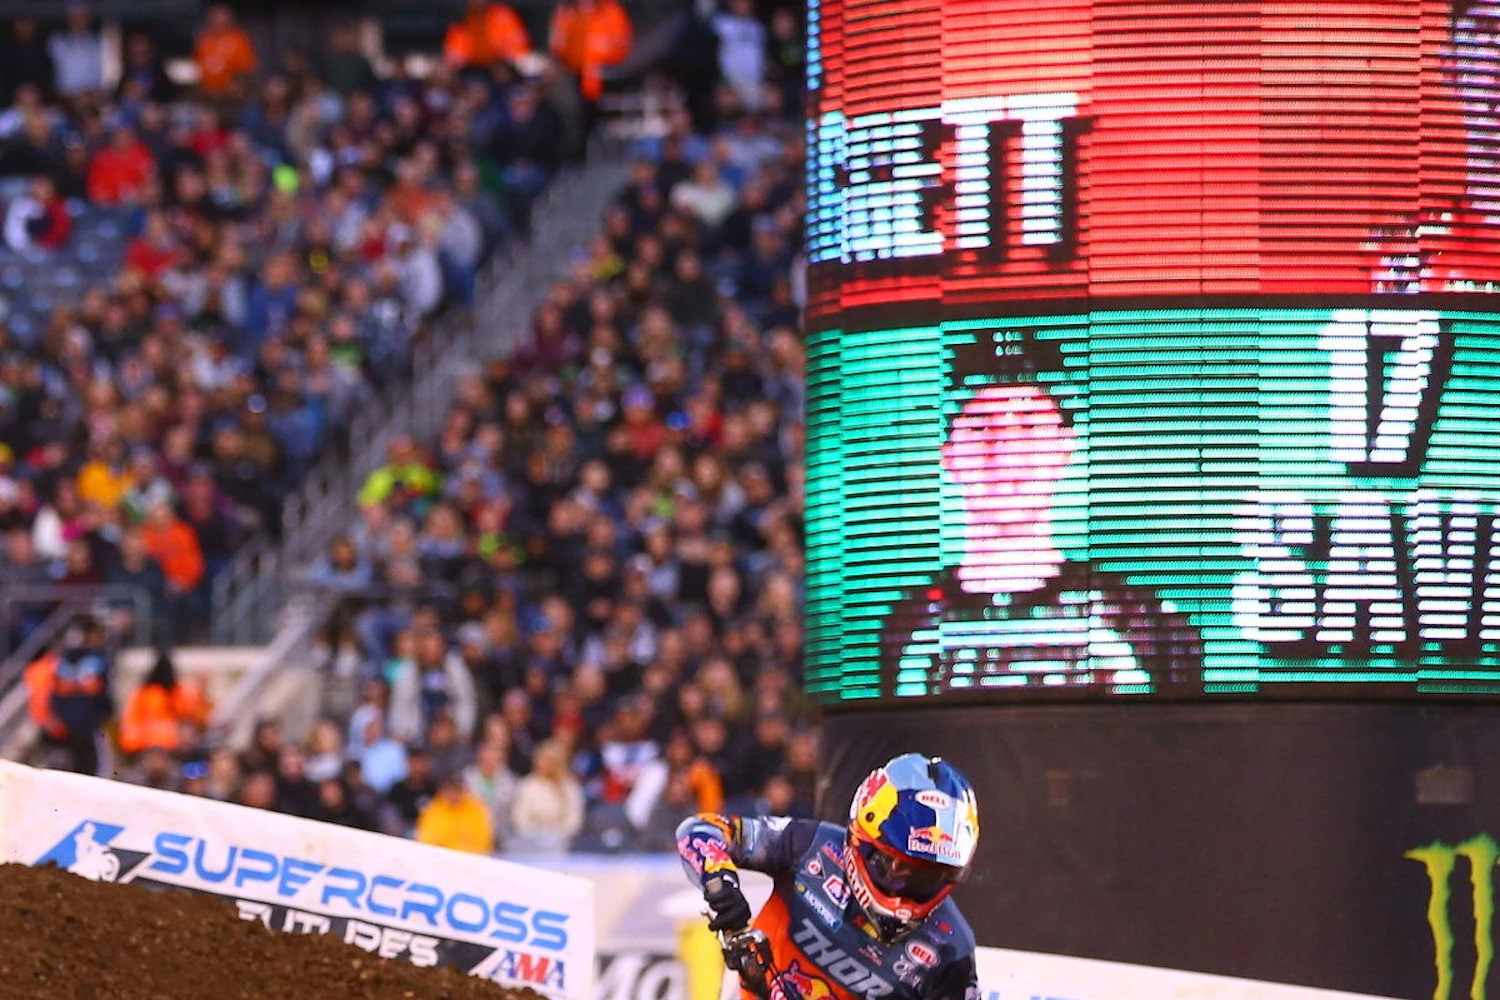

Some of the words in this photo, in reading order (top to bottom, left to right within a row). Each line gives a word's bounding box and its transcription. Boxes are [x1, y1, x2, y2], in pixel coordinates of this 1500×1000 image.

[1318, 308, 1439, 462] 17
[150, 831, 568, 951] SUPERCROSS
[490, 949, 564, 988] AMA
